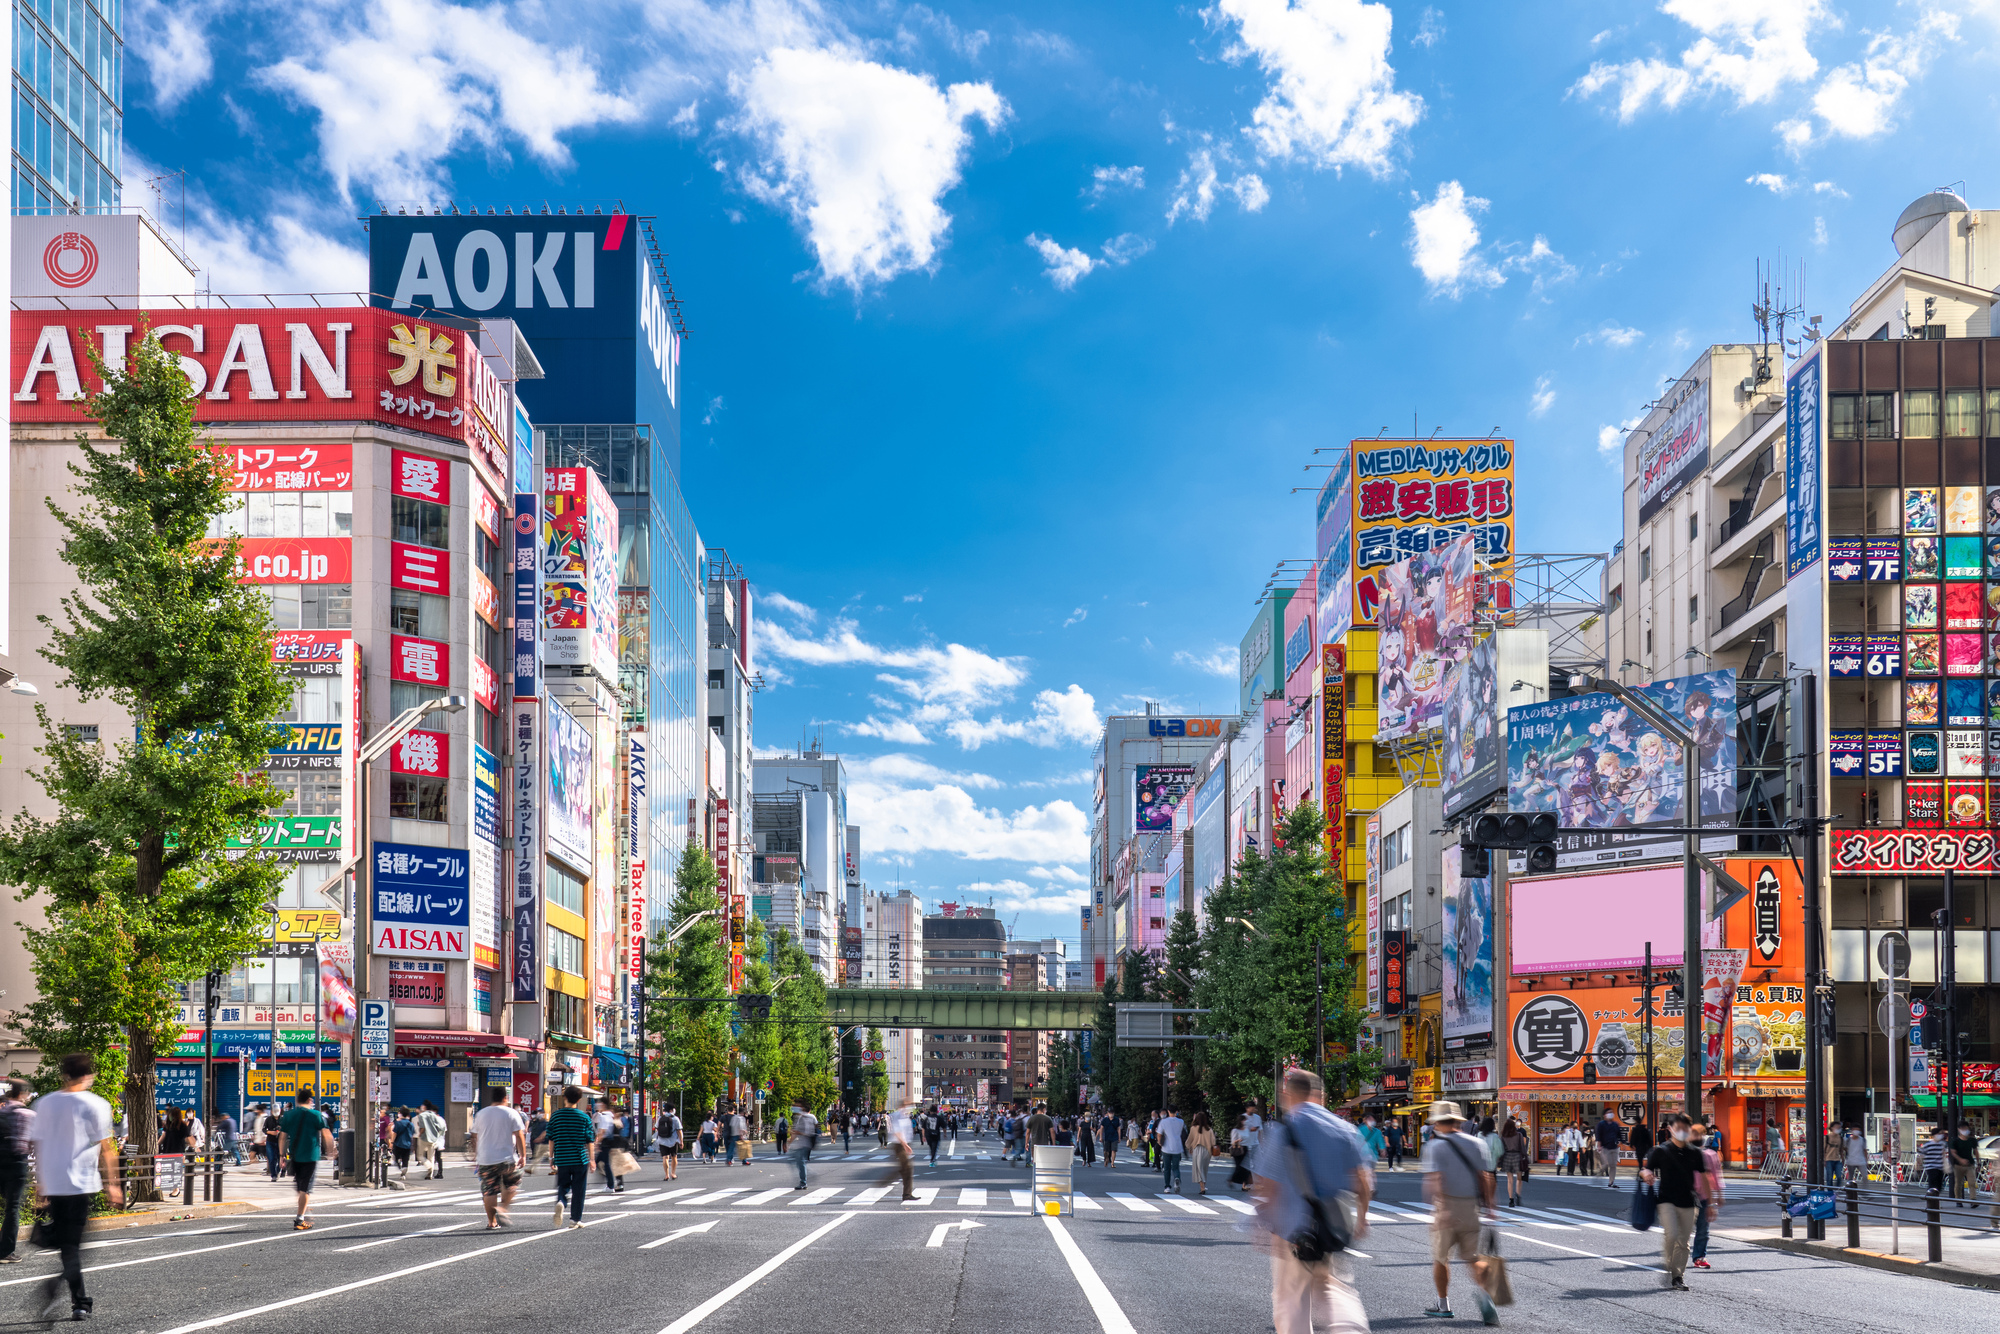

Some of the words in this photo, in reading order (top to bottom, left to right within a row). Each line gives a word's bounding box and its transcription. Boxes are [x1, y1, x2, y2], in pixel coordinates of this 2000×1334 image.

[391, 230, 595, 311] AOKI
[640, 256, 676, 409] AOKI
[14, 323, 352, 401] AISAN
[388, 323, 457, 398] 光
[380, 389, 464, 427] ネットワーク
[474, 350, 508, 447] AISAN
[1357, 443, 1510, 477] MEDIAリサイクル
[1644, 412, 1703, 494] メイドカジノ
[1358, 478, 1510, 520] 激安販売
[1868, 560, 1899, 580] 7F
[516, 547, 535, 678] 愛三電機
[550, 643, 579, 651] Tax-free
[552, 634, 579, 643] Japan.
[1286, 614, 1313, 682] SEGA
[560, 651, 579, 659] Shop
[1867, 655, 1900, 675] 6F
[1325, 686, 1342, 694] DVD
[1328, 710, 1340, 718] CD
[630, 738, 646, 797] AKKY
[1869, 752, 1900, 773] 5F
[630, 782, 640, 858] INTERNATIONAL
[1325, 764, 1343, 880] お売り下さ
[1909, 808, 1939, 818] Stars
[377, 851, 465, 878] 各種ケーブル
[1569, 855, 1594, 864] Windows
[378, 890, 463, 916] 配線パーツ
[631, 859, 646, 933] Tax-free
[377, 927, 464, 953] AISAN
[518, 910, 532, 992] AISAN
[389, 981, 444, 1003] aisan.co.jp
[1735, 985, 1753, 1003] 質
[1768, 986, 1804, 1003] 買取
[365, 1003, 384, 1026] P
[1593, 1008, 1629, 1020] チケット
[1913, 1004, 1924, 1014] 40
[212, 1033, 271, 1041] T・ネットワーク機器
[414, 1033, 476, 1042] http://www.aisan.co.jp
[1521, 1006, 1579, 1065] 質
[417, 1059, 434, 1067] 1949
[1455, 1069, 1472, 1082] COMIC
[1472, 1068, 1481, 1081] ZIN
[1973, 1081, 1993, 1089] FOOD
